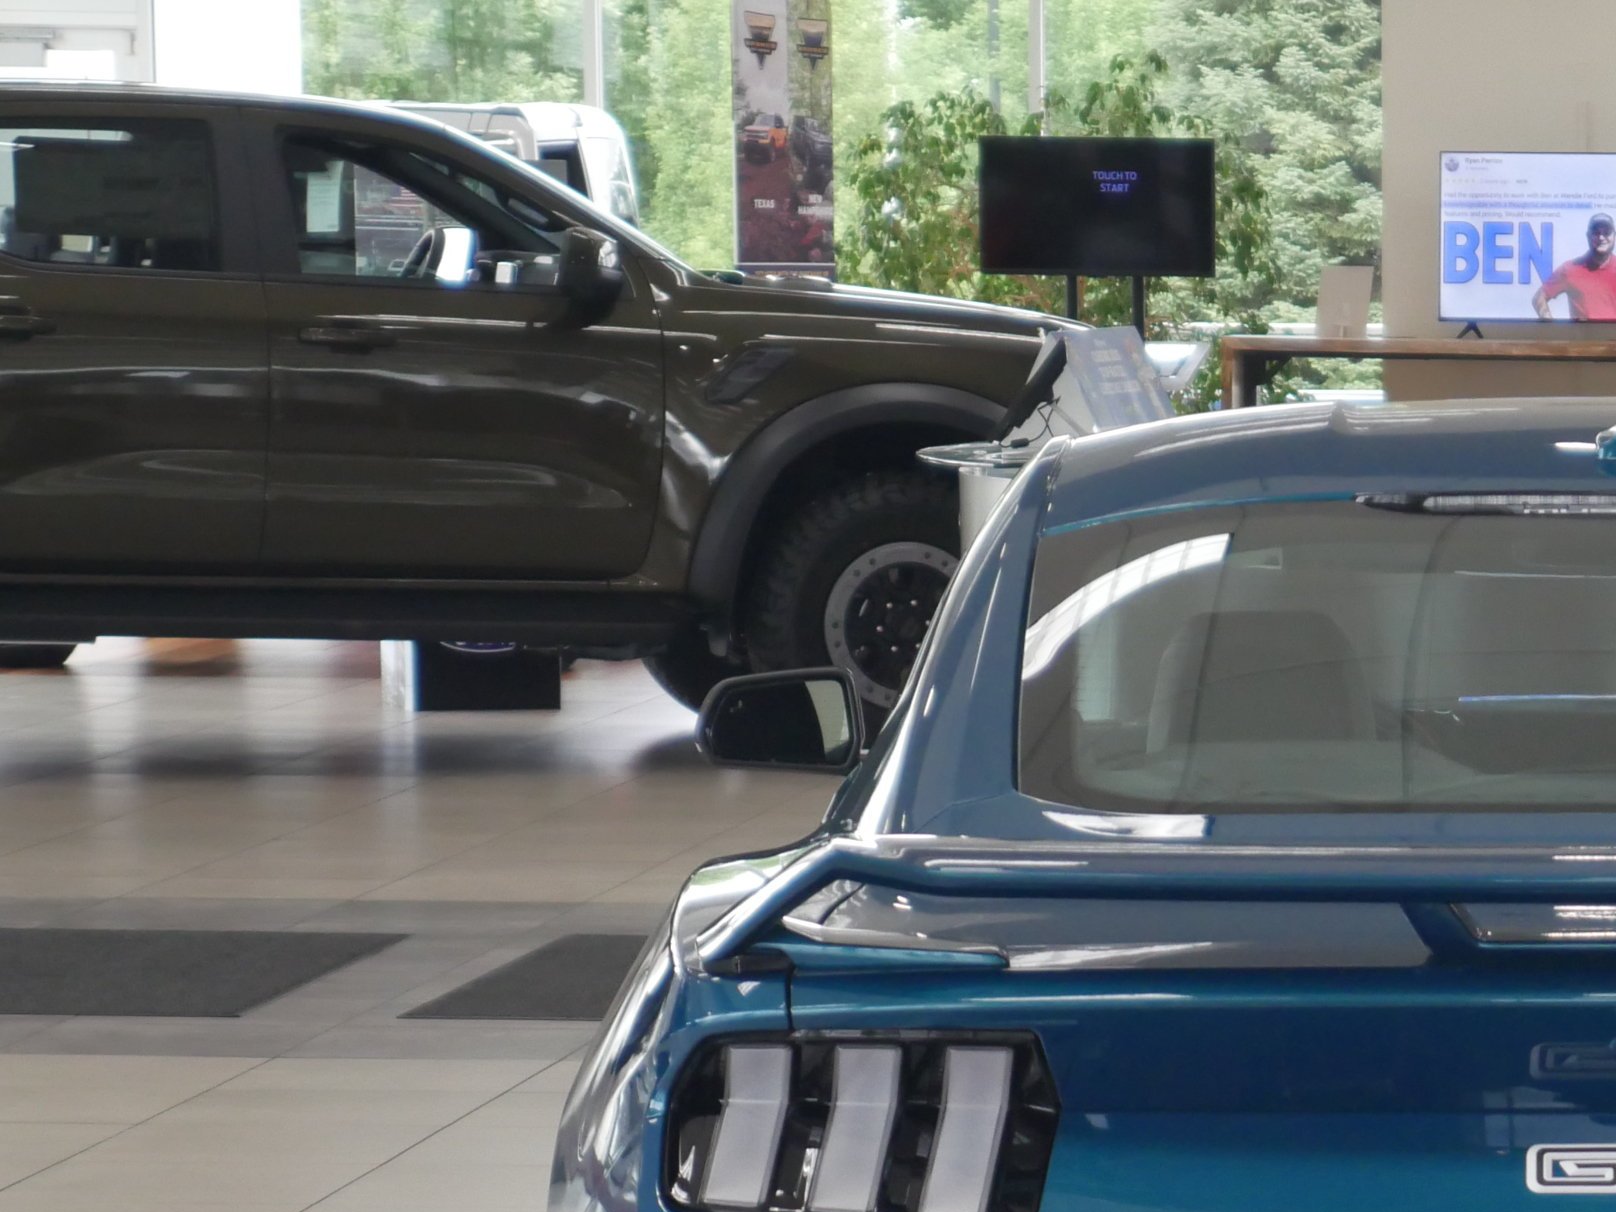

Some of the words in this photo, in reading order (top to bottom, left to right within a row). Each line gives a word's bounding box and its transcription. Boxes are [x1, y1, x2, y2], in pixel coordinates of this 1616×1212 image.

[1092, 170, 1123, 180] TOUCH
[1124, 171, 1137, 180] TO
[1100, 183, 1129, 192] START
[753, 199, 776, 208] TEXAS
[1443, 221, 1554, 285] BEN
